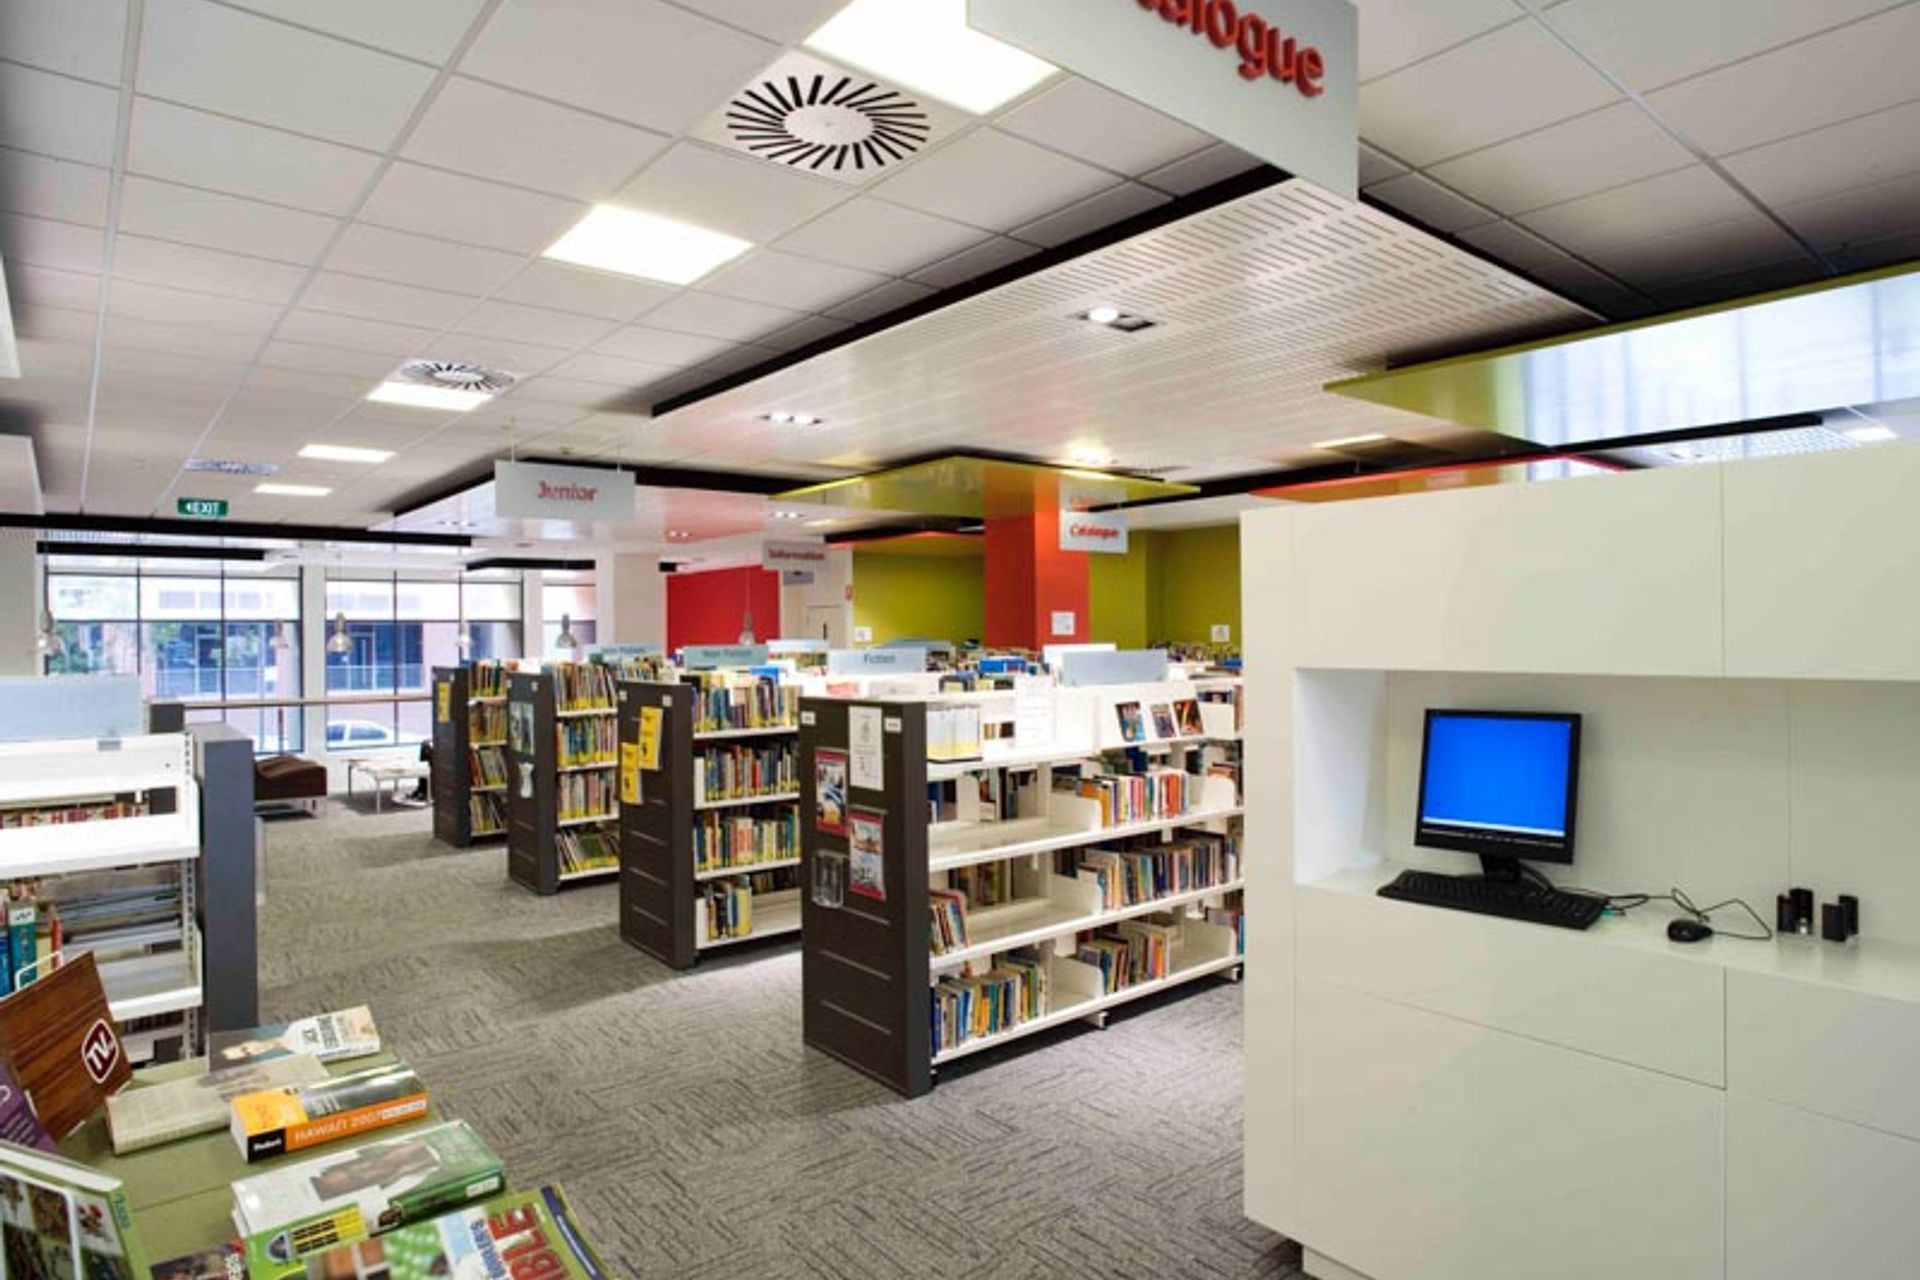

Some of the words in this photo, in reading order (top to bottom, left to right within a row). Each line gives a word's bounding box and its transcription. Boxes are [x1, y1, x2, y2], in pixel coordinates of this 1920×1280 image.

[537, 481, 598, 501] Junior
[192, 501, 219, 513] EXIT
[1070, 523, 1118, 541] Catalogue
[864, 653, 896, 663] Fiction
